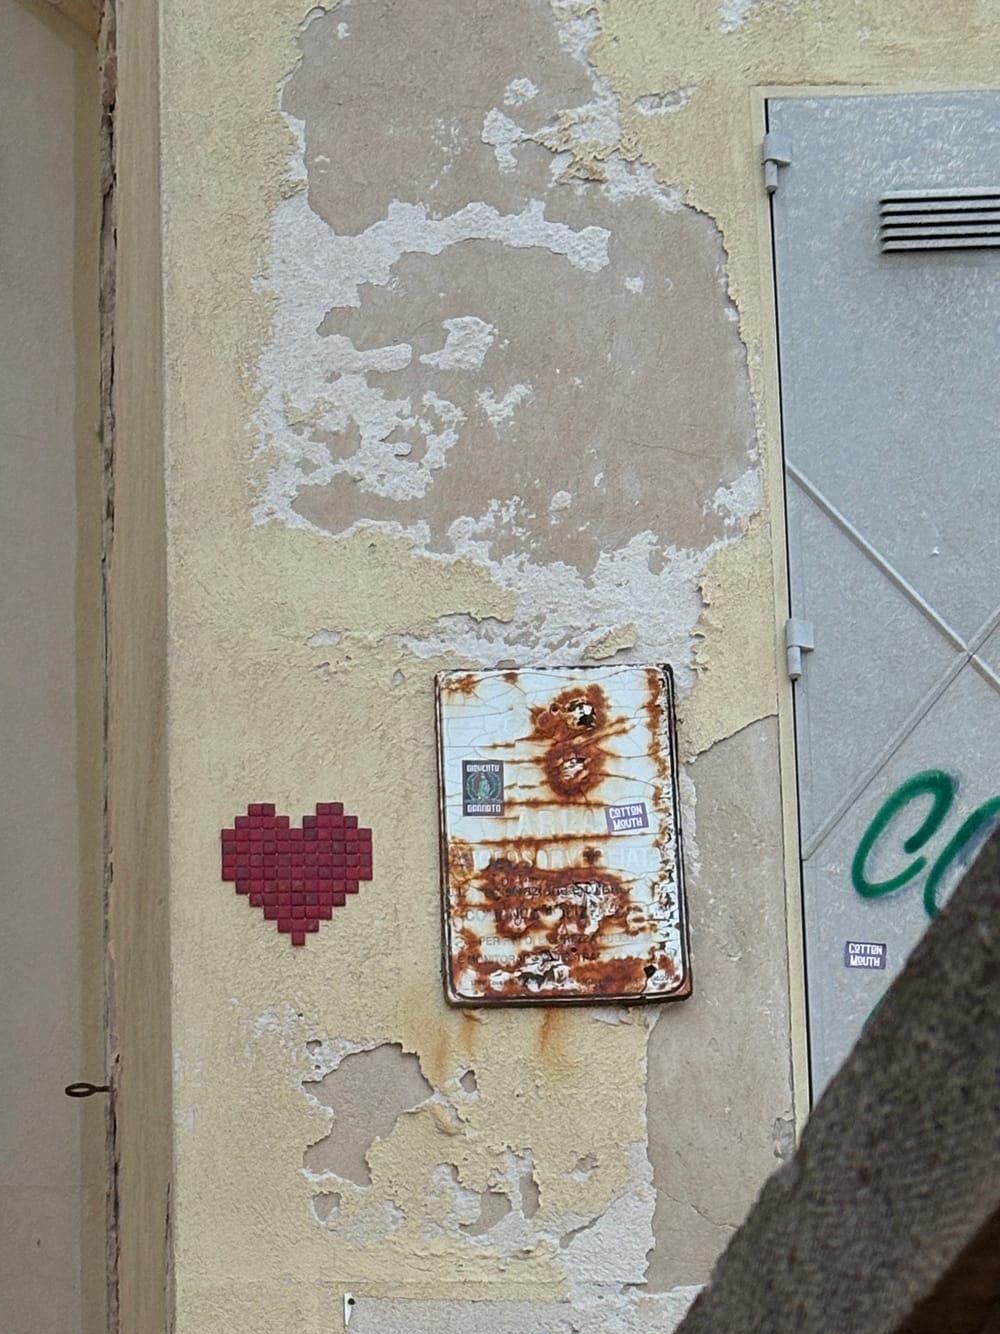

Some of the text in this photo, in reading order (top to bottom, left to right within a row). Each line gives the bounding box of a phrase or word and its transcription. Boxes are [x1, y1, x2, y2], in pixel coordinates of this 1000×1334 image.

[609, 805, 643, 819] COTTON
[612, 817, 643, 831] MOUTH
[849, 943, 883, 955] COTTON
[850, 955, 881, 967] MOUTH
